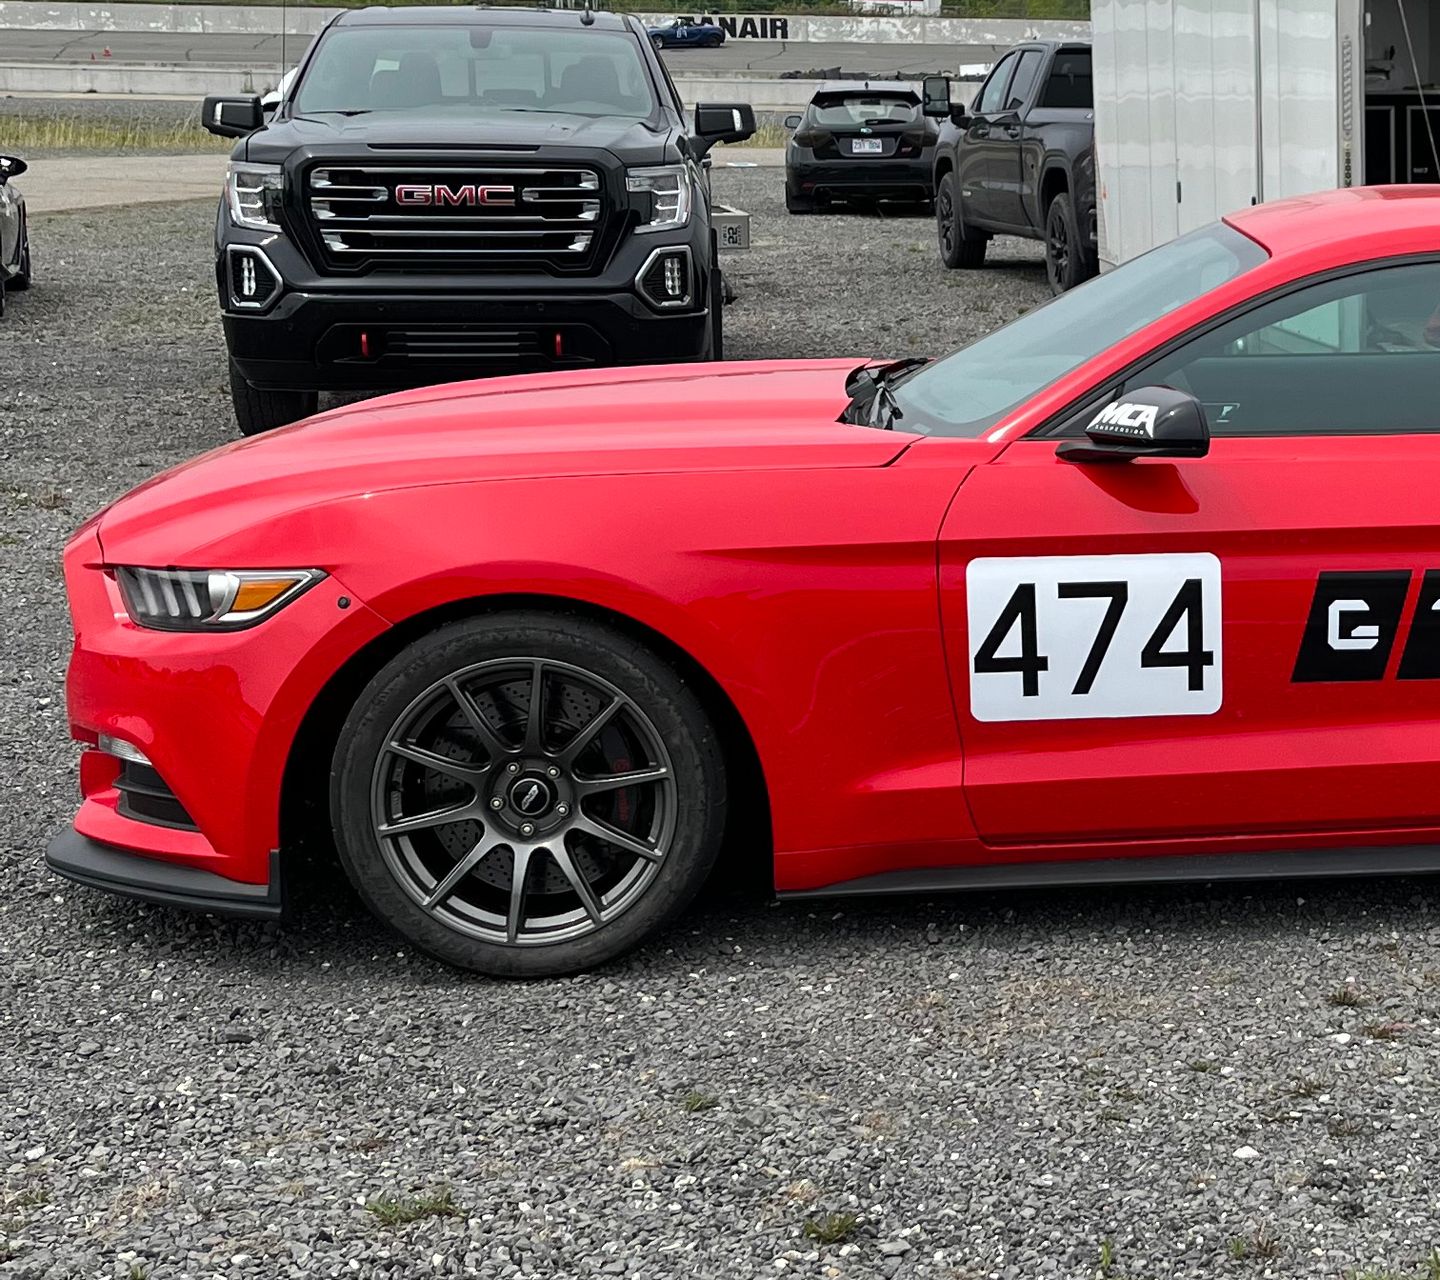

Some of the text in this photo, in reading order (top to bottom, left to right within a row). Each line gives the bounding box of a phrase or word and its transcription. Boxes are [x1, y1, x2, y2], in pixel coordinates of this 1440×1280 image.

[678, 16, 788, 39] NAIR
[395, 184, 516, 206] GMC
[1086, 401, 1159, 438] MCA
[973, 578, 1215, 697] 474
